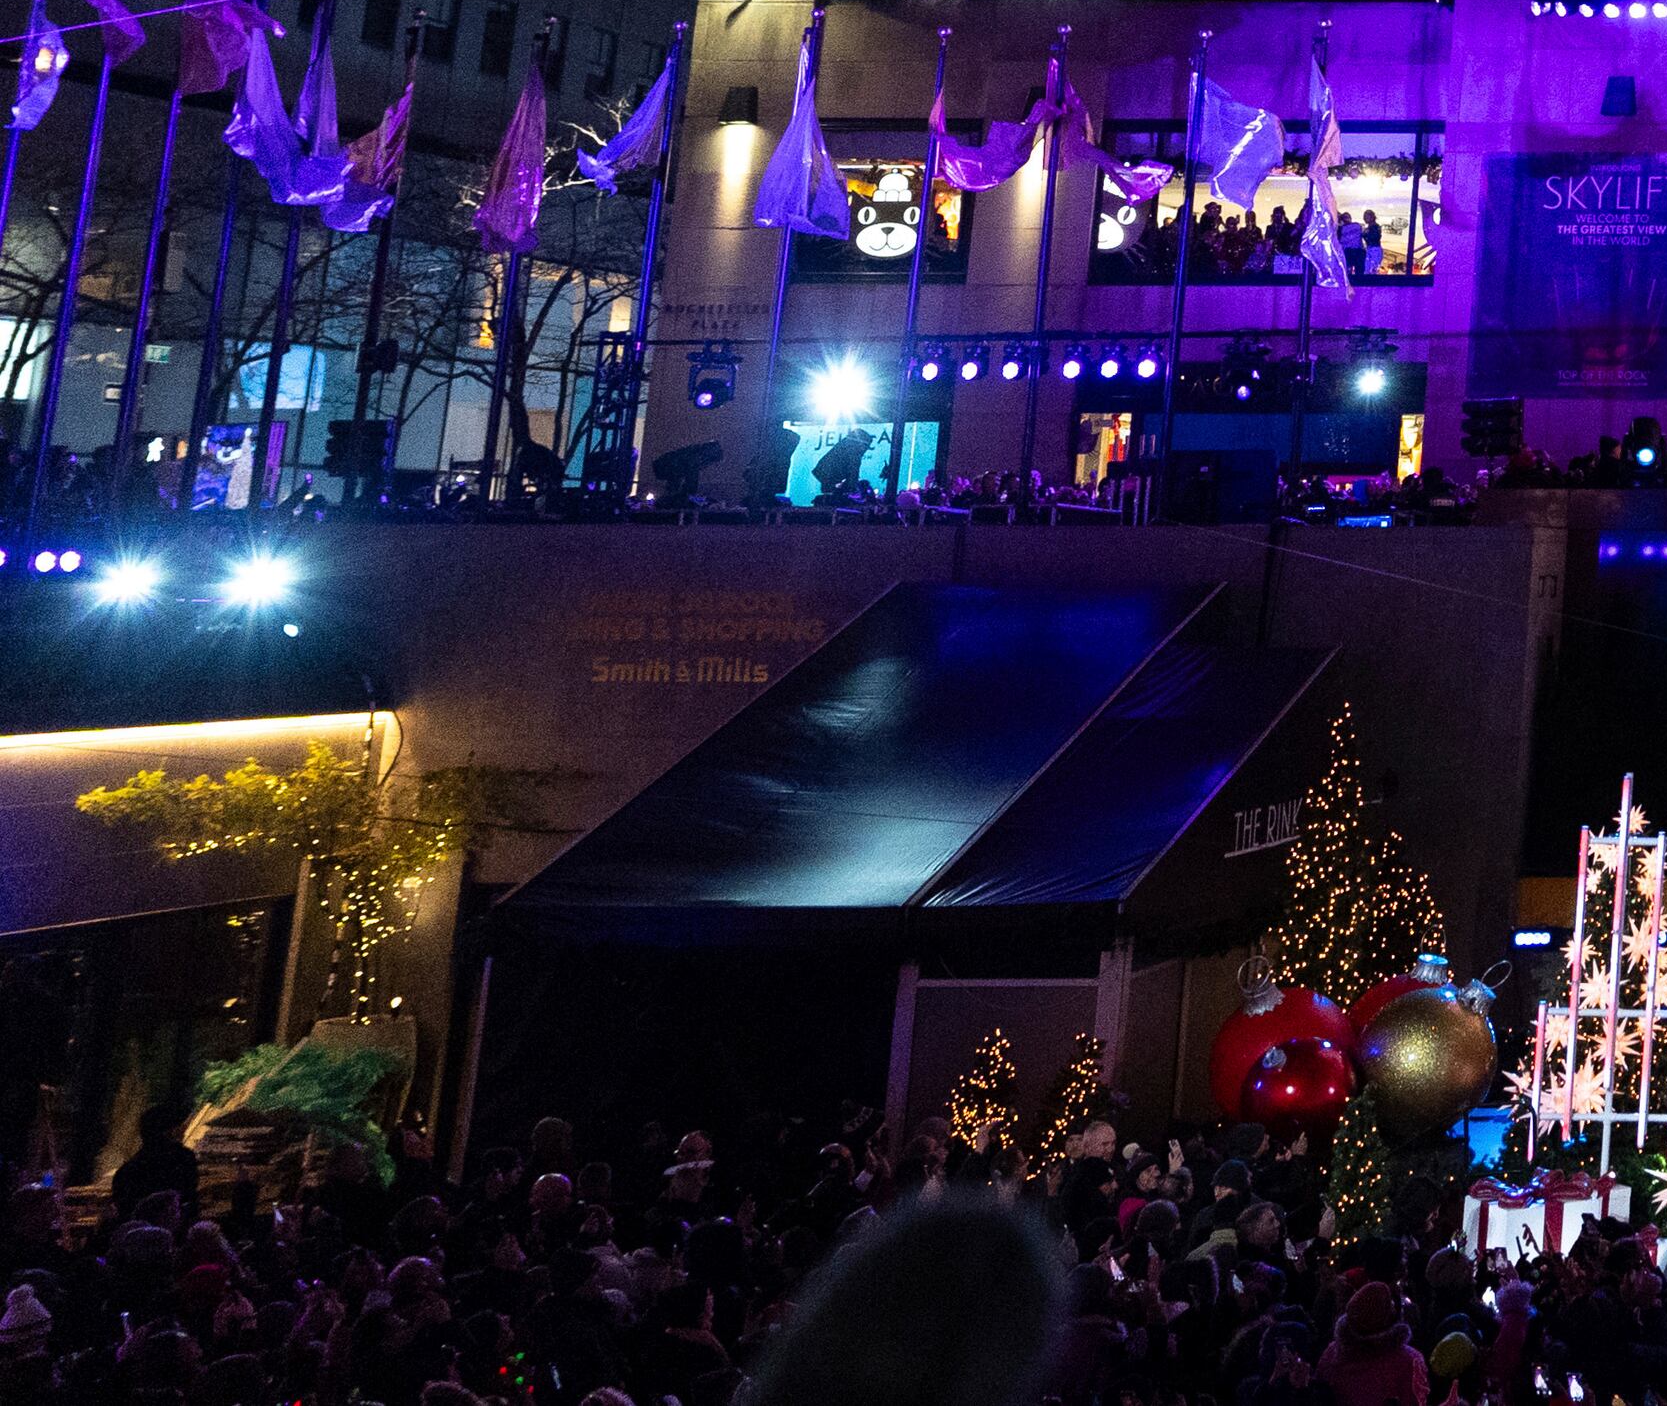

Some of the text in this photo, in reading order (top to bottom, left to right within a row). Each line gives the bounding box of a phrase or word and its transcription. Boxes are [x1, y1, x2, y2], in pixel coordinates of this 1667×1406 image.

[1576, 214, 1649, 224] WELCOME TO
[1557, 225, 1667, 235] THE GREATEST VIEW
[1572, 236, 1650, 245] IN THE WORLD
[592, 657, 768, 683] Smith & Mills
[1234, 796, 1304, 851] THE RINK
